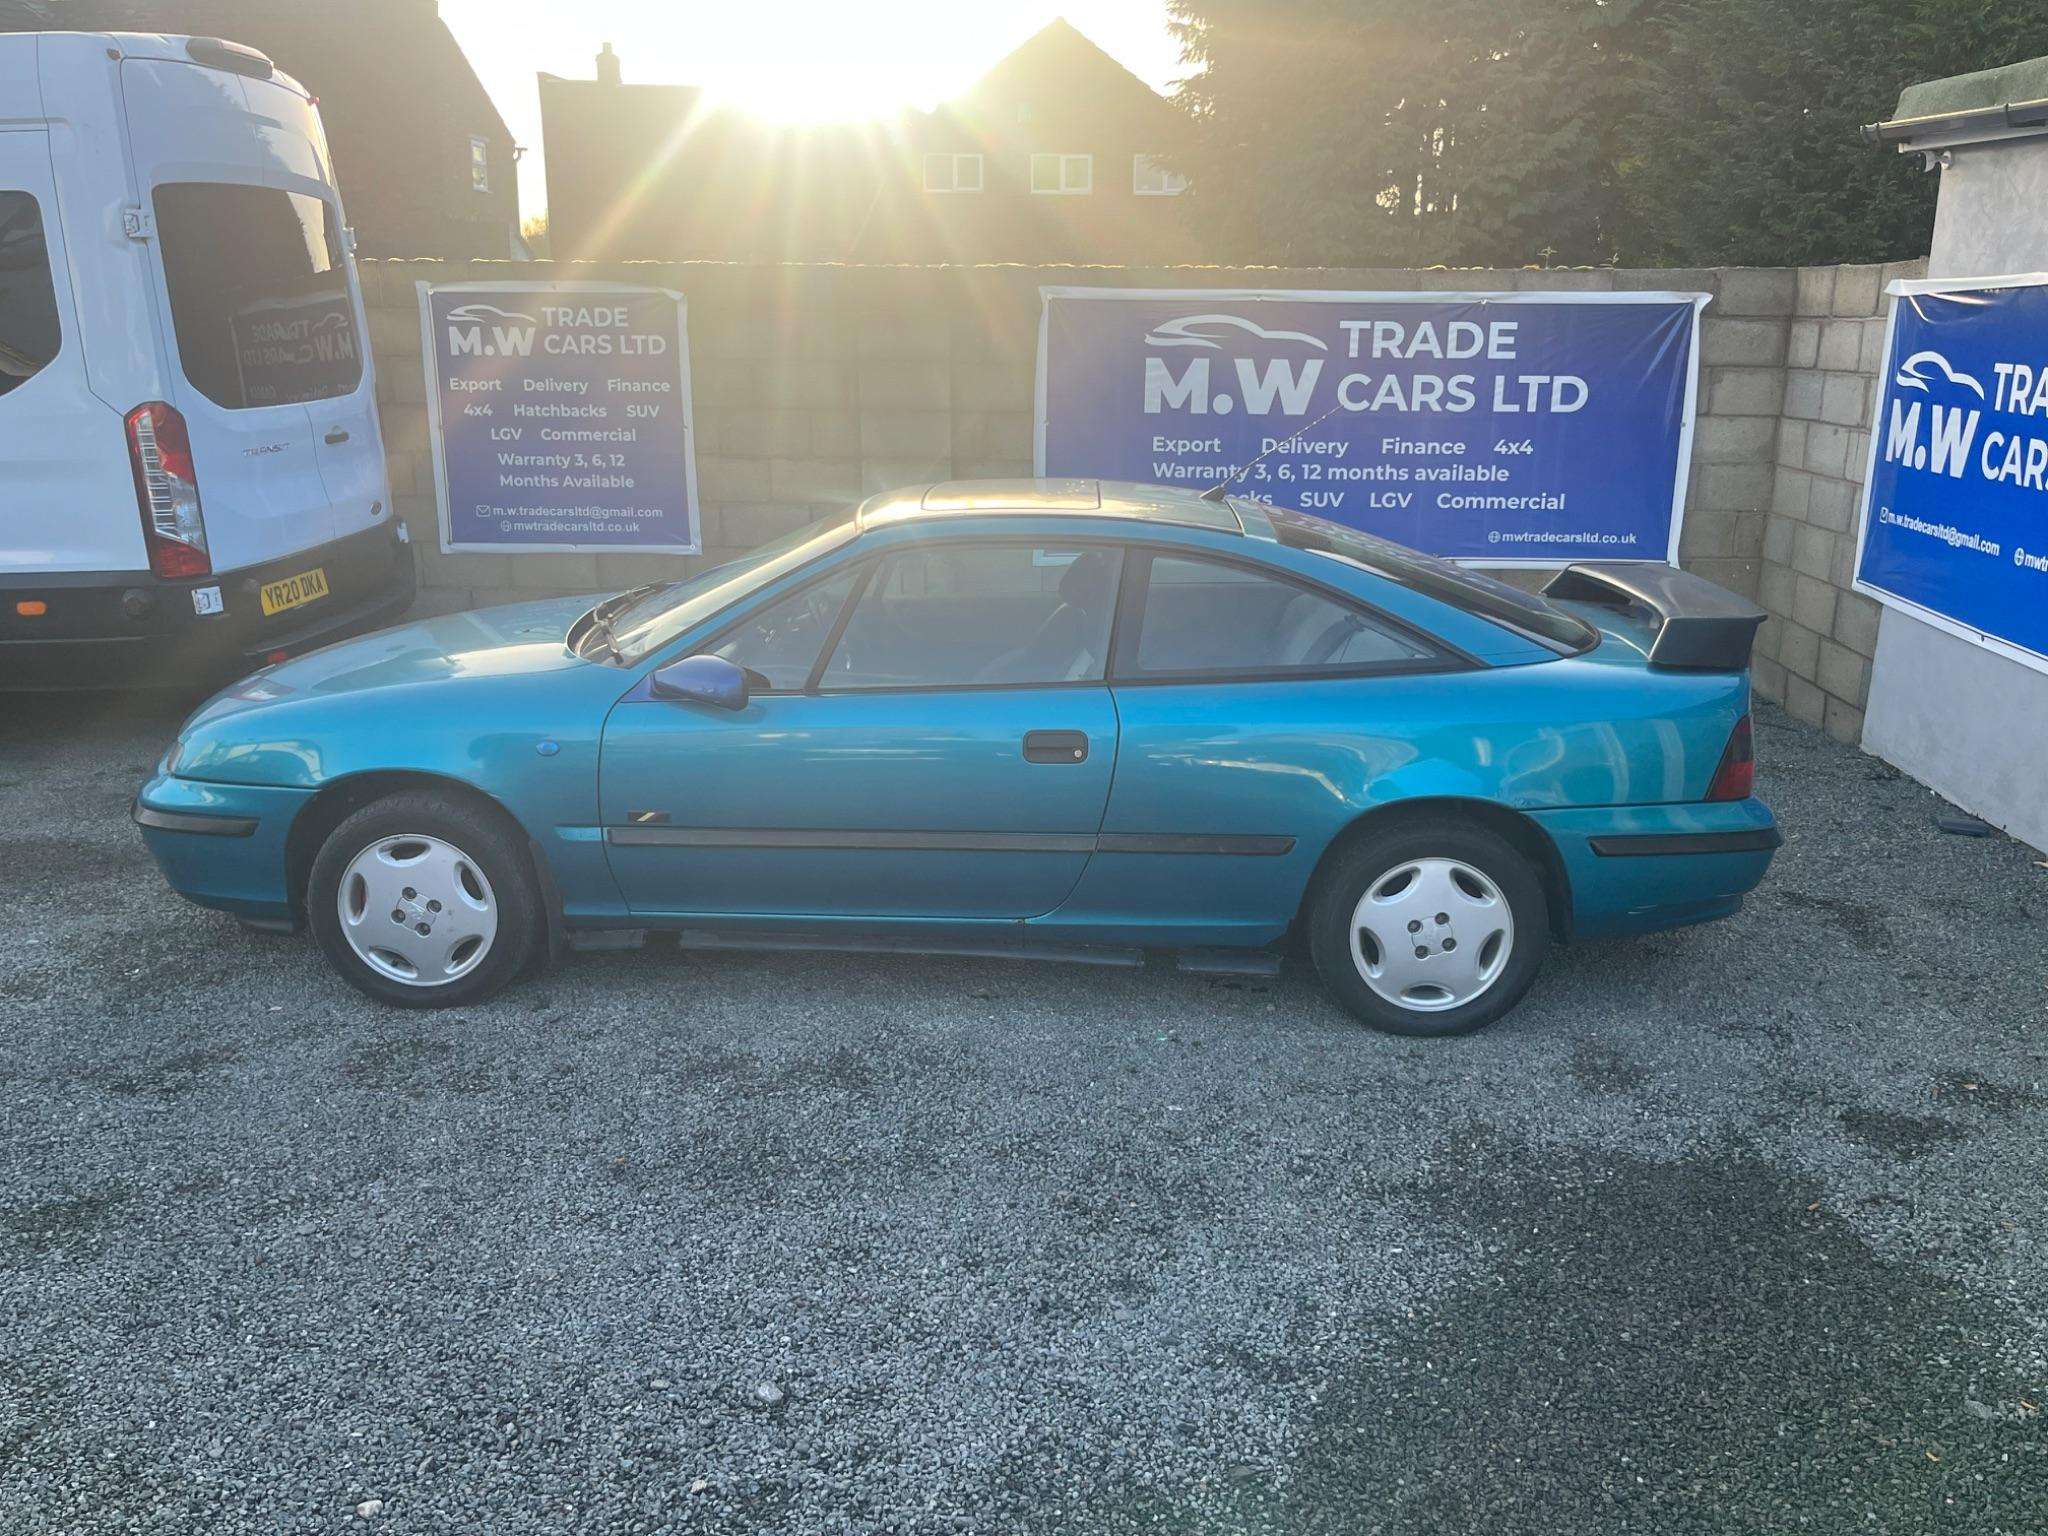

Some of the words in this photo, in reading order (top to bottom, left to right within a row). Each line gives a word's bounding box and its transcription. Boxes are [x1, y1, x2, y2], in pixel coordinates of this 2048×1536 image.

[541, 307, 629, 328] TRADE
[448, 326, 537, 356] M.W
[544, 335, 613, 355] CARS
[619, 335, 666, 355] LTD
[1339, 320, 1518, 360] TRADE
[449, 378, 503, 395] Export
[523, 379, 589, 396] Delivery
[607, 379, 671, 393] Finance
[1143, 357, 1325, 416] M.W
[1337, 373, 1476, 413] CARS
[1493, 375, 1589, 414] LTD
[463, 404, 494, 417] 4x4
[513, 404, 608, 418] Hatchbacks
[626, 405, 660, 418] SUV
[490, 428, 522, 442] LGV
[540, 429, 637, 442] Commercial
[1884, 398, 1981, 479] M.W
[1152, 436, 1221, 456] Export
[1261, 437, 1349, 458] Delivery
[1381, 437, 1466, 455] Finance
[1493, 439, 1534, 455] 4x4
[498, 453, 571, 469] Warranty
[574, 454, 588, 468] 3,
[592, 454, 607, 468] 6,
[610, 454, 625, 467] 12
[1981, 431, 2048, 491] CAR
[500, 475, 559, 488] Months
[563, 475, 635, 489] Available
[1153, 462, 1250, 483] Warranty
[1254, 463, 1272, 482] 3,
[1277, 463, 1296, 482] 6,
[1303, 464, 1322, 480] 12
[1327, 464, 1409, 481] months
[1414, 464, 1510, 482] available
[493, 505, 663, 519] m.w.tradecarsltd@gmail.com
[1300, 492, 1344, 508] SUV
[1370, 492, 1413, 508] LGV
[1437, 493, 1566, 511] Commercial
[513, 520, 640, 533] mwtradecarsltd.co.uk
[1888, 511, 2000, 556] m.w.tradecarsltd@gmail.com
[1502, 531, 1637, 544] mwtradecarsltd.co.uk
[264, 580, 301, 610] YR20
[302, 572, 324, 598] DKA
